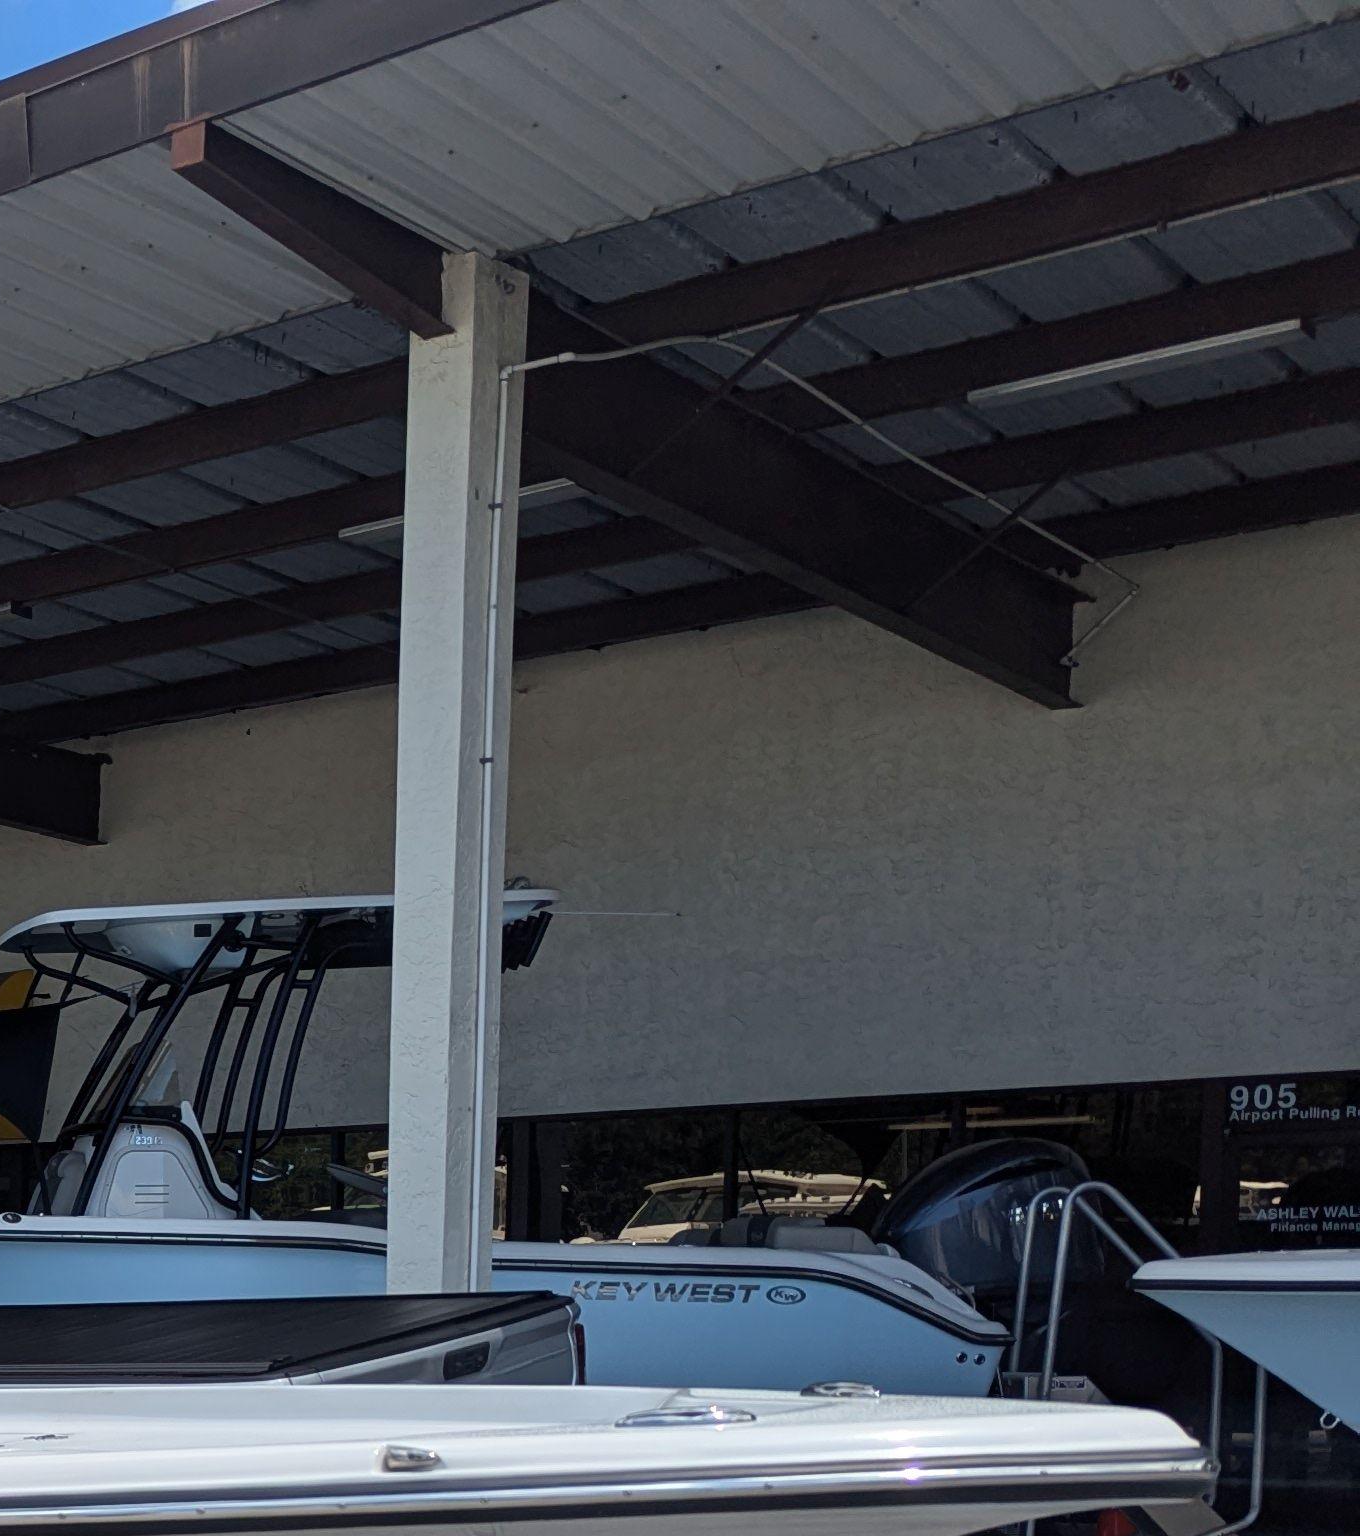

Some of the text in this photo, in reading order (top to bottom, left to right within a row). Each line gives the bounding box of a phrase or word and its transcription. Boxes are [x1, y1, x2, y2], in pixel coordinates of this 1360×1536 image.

[1230, 1082, 1297, 1111] 905
[1228, 1104, 1360, 1124] Airport Pulling R
[1256, 1205, 1360, 1221] ASHLEY WAL
[1270, 1220, 1360, 1233] Finance Manag
[653, 1282, 761, 1304] WEST
